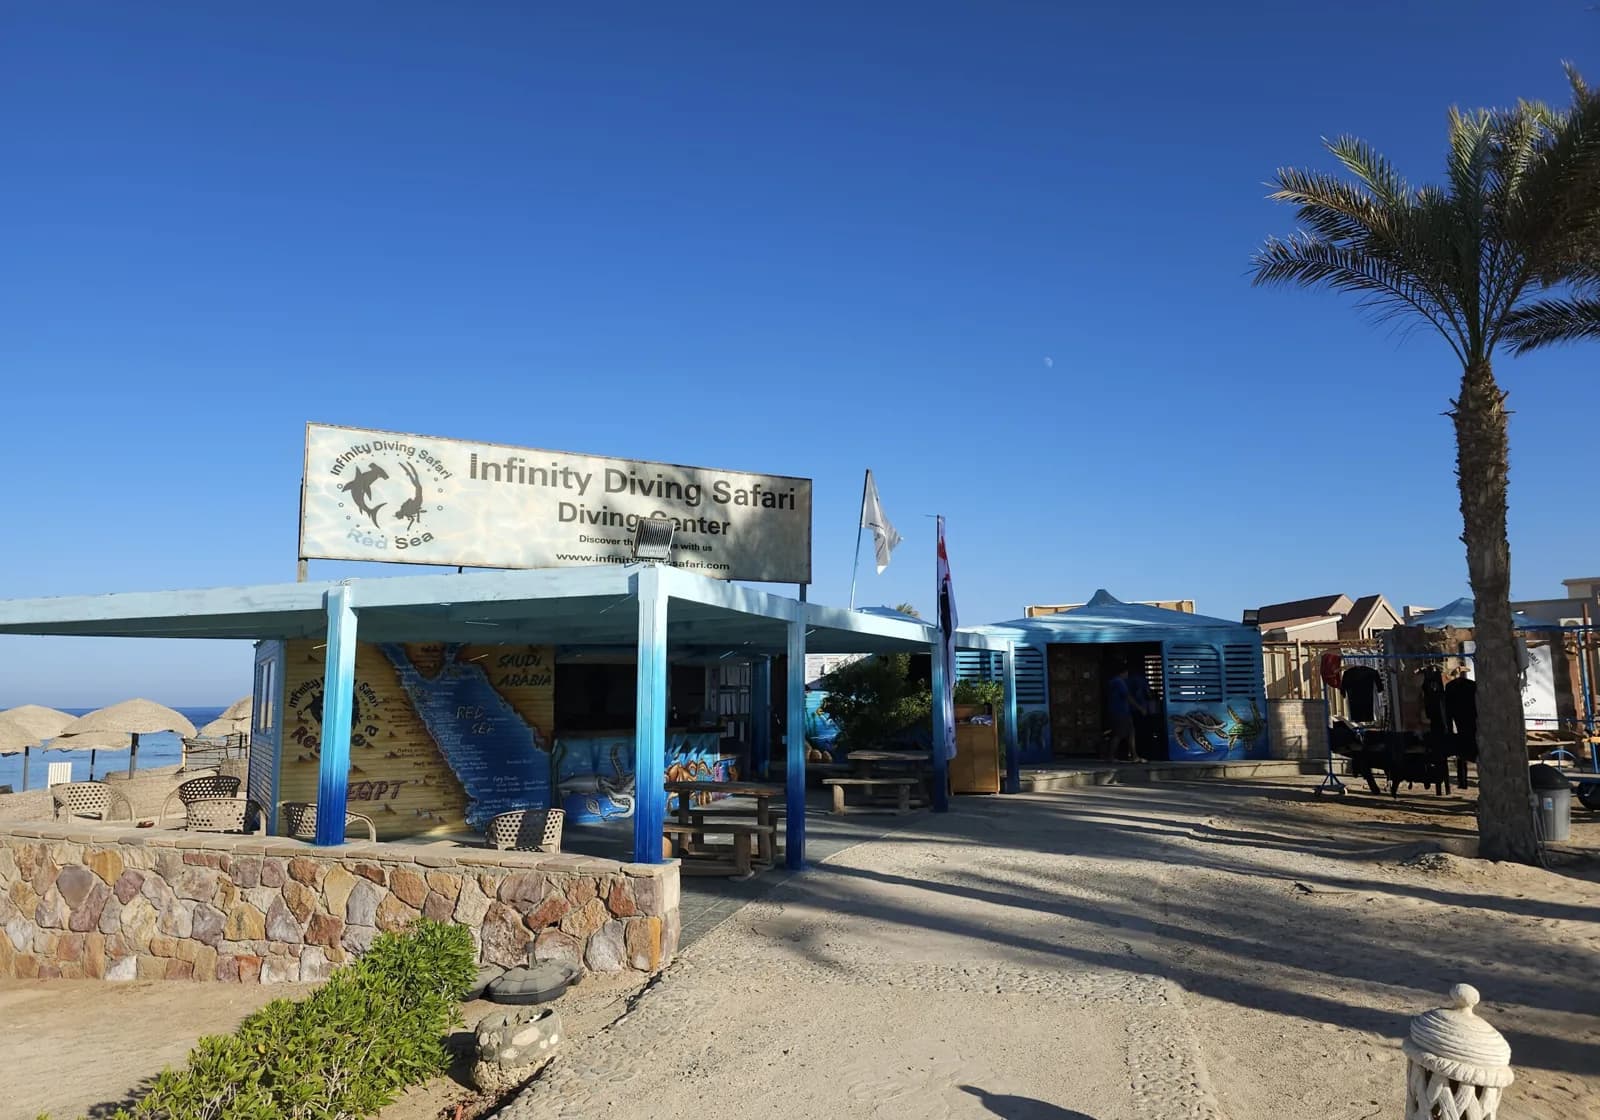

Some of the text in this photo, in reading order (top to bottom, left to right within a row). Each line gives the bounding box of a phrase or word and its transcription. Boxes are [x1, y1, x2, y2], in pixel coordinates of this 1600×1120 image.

[330, 440, 453, 480] Infinity Diving Safari
[470, 453, 795, 510] Infinity Diving Safari
[558, 501, 640, 533] Diving
[347, 529, 434, 550] Red Sea
[579, 534, 621, 545] Discover
[681, 544, 700, 552] with
[498, 653, 542, 668] SAUDI
[497, 674, 553, 687] ARABIA
[289, 679, 321, 709] Infinity
[350, 724, 379, 747] ea
